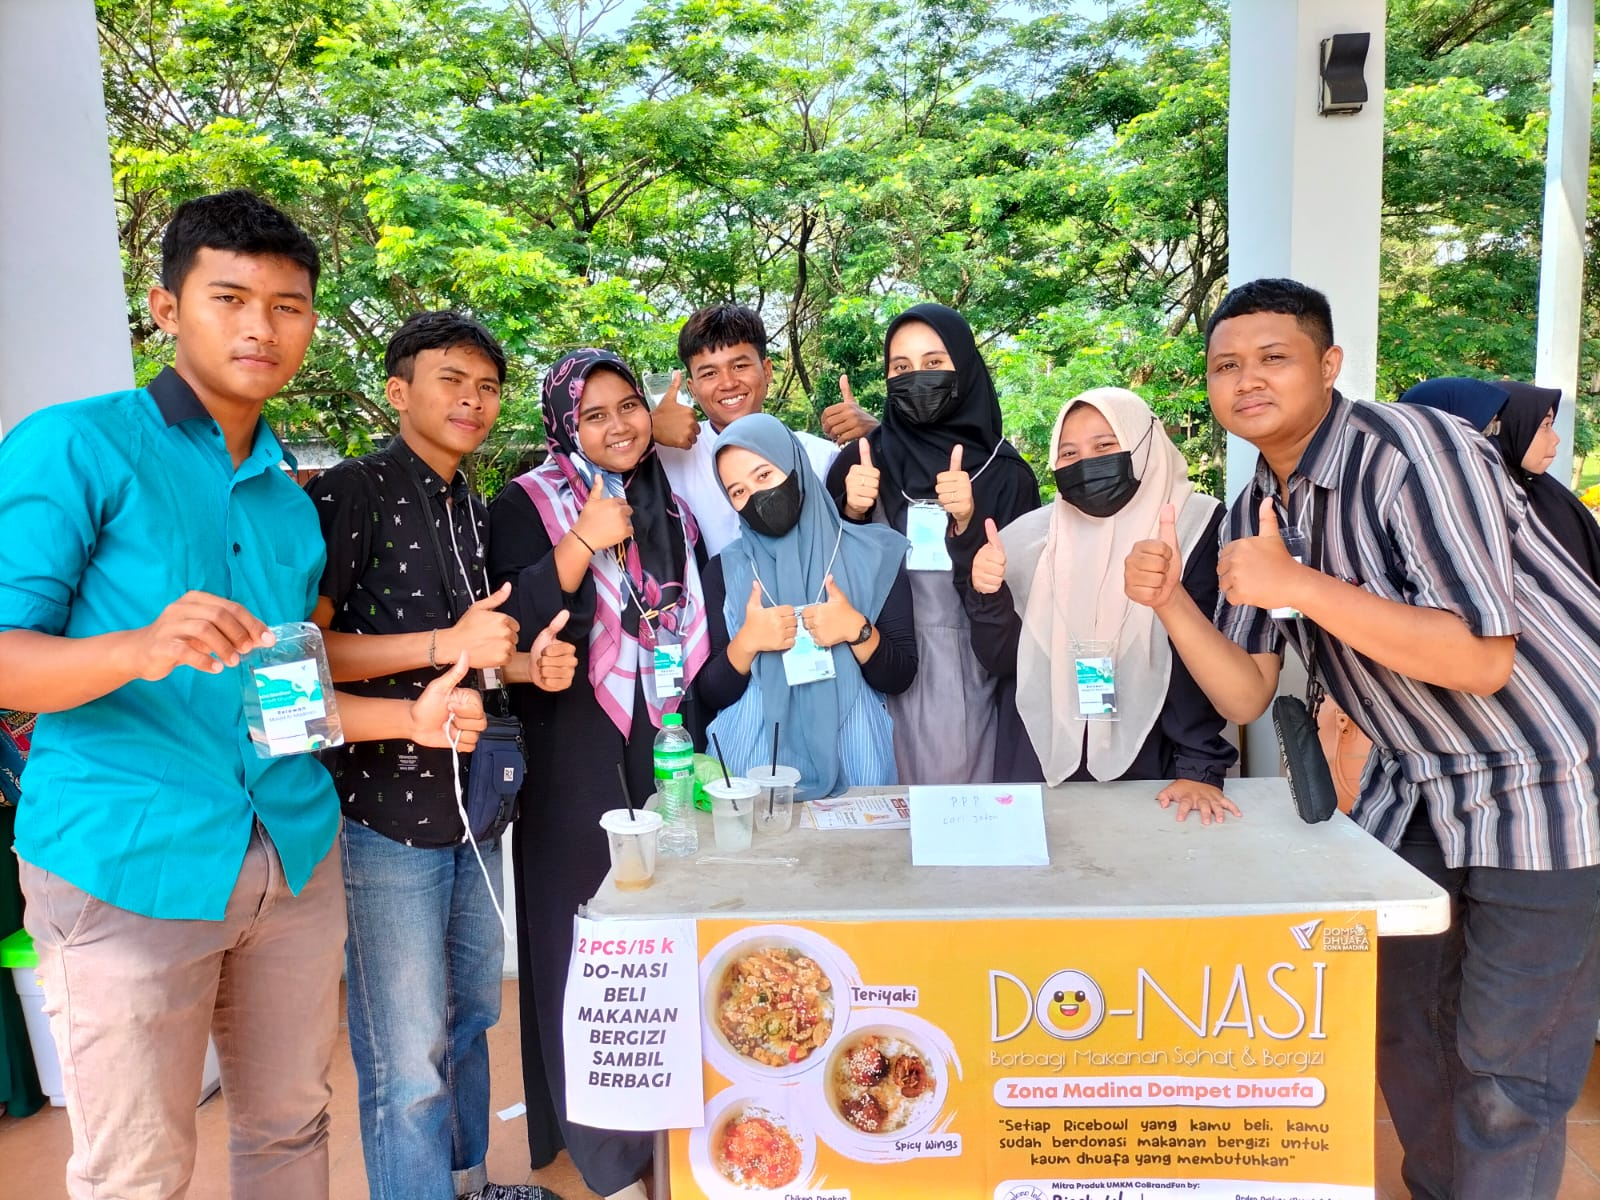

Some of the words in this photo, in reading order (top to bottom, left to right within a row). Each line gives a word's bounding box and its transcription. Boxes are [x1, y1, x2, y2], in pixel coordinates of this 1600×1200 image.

[578, 938, 586, 953] 2
[590, 939, 655, 955] PCS/15
[1323, 936, 1369, 945] DHUAFA
[583, 963, 667, 978] DO-NASI
[603, 987, 645, 1002] BELI
[852, 987, 917, 1004] Teriyaki
[578, 1007, 677, 1023] MAKANAN
[589, 1030, 665, 1045] BERGIZI
[592, 1051, 664, 1066] SAMBIL
[1073, 1049, 1168, 1066] Makanan
[1241, 1046, 1257, 1066] &
[588, 1071, 671, 1088] BERBAGI
[1007, 1084, 1058, 1099] Zona
[1063, 1083, 1142, 1099] Madina
[1148, 1083, 1231, 1102] Dompet
[1236, 1083, 1314, 1099] Dhuafa
[1063, 1119, 1129, 1132] Ricebowl
[1141, 1119, 1177, 1133] yang
[1190, 1119, 1231, 1132] kamu
[1286, 1119, 1330, 1133] kamu
[895, 1140, 922, 1153] Spicy
[925, 1139, 959, 1152] Wings
[999, 1136, 1042, 1149] sudah
[1052, 1136, 1127, 1149] berdonasi
[1137, 1136, 1207, 1149] makanan
[1217, 1136, 1270, 1150] bergizi
[1281, 1137, 1330, 1151] untuk
[1031, 1153, 1071, 1166] kaum
[1076, 1152, 1130, 1166] dhuafa
[1135, 1153, 1171, 1167] yang
[1106, 1181, 1133, 1189] UMKM
[1187, 1182, 1200, 1190] by:
